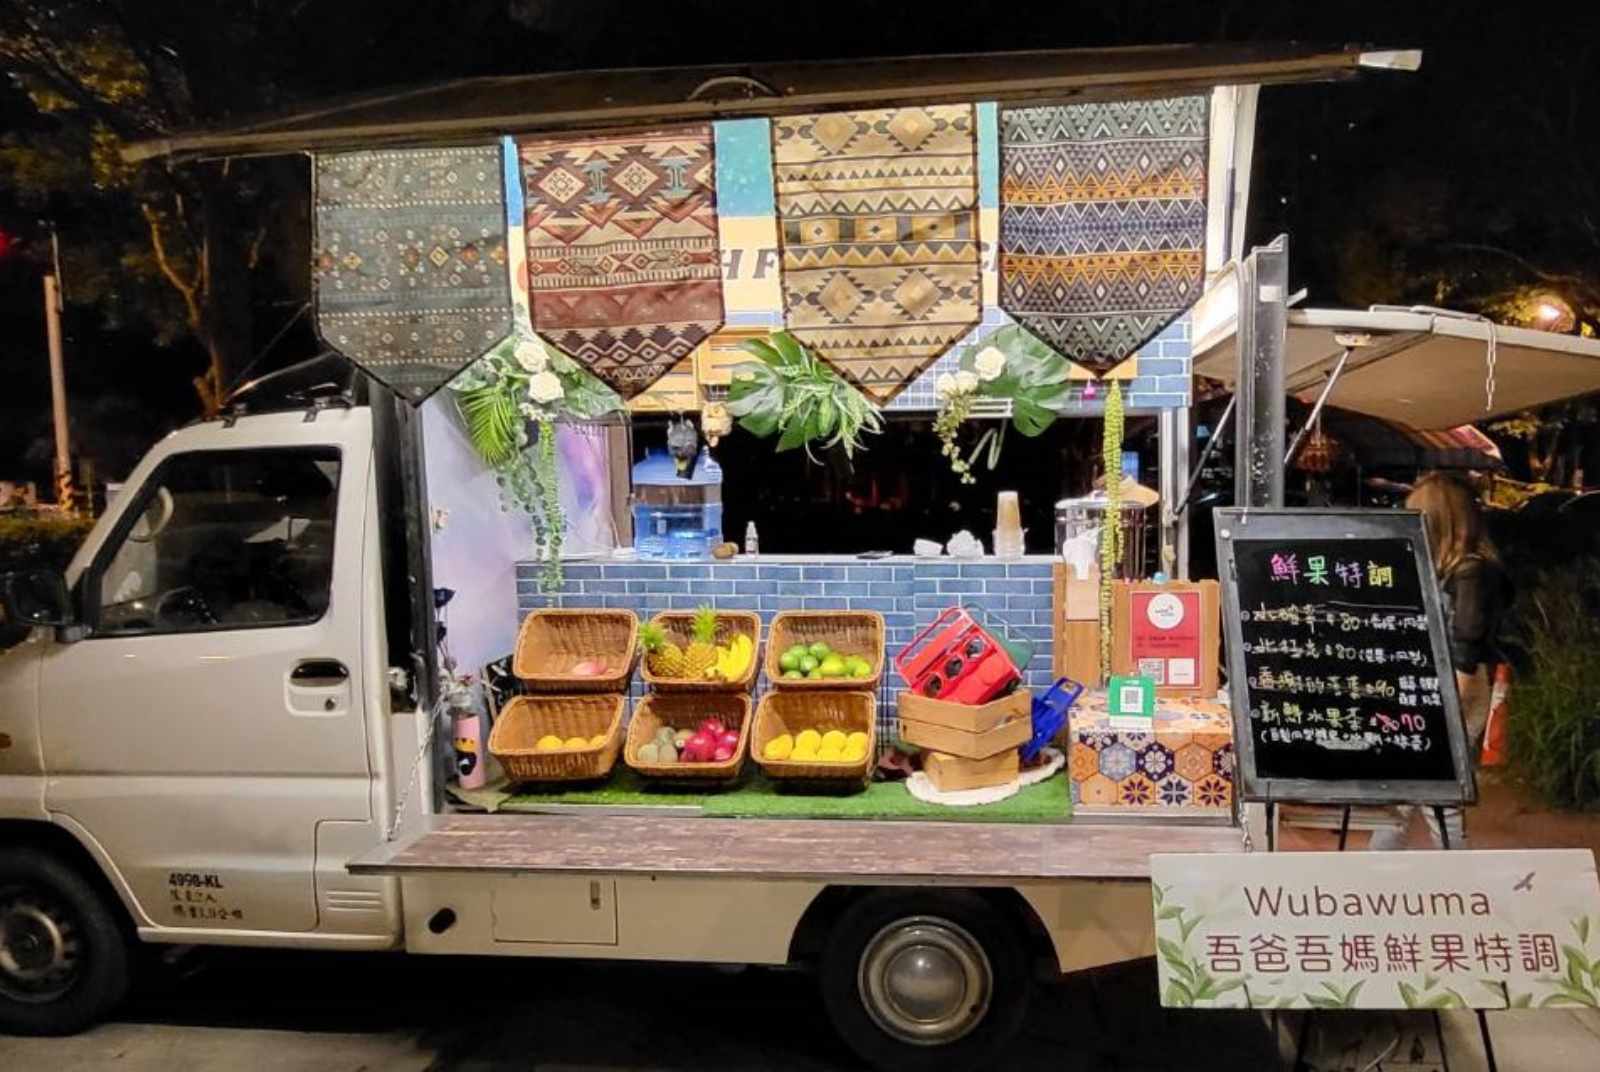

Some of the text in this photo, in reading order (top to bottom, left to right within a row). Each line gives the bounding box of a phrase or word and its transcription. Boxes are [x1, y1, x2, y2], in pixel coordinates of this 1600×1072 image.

[1268, 553, 1394, 589] 鮮果特調
[1244, 885, 1491, 918] Wubawuma
[1205, 932, 1561, 975] 吾爸吾媽鮮果特調
